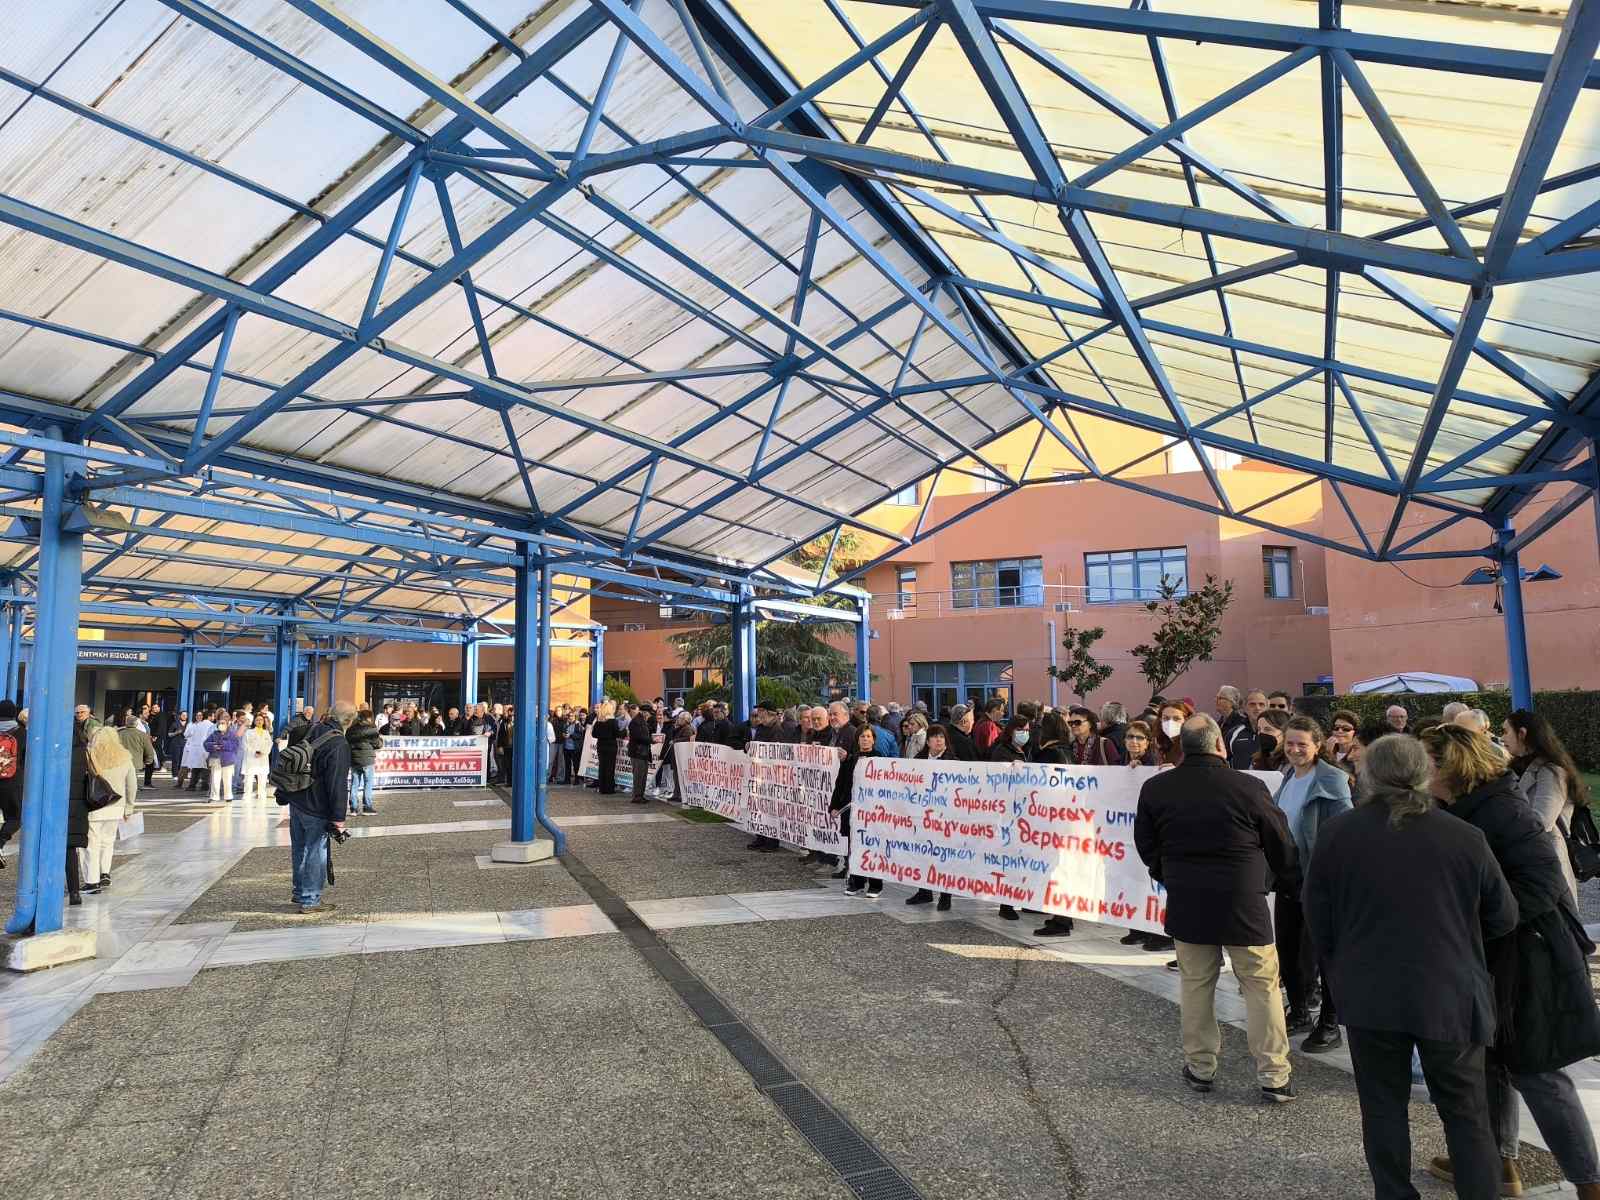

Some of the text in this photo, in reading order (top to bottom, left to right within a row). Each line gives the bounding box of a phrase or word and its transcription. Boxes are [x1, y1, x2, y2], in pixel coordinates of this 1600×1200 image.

[77, 650, 108, 658] ΕΝΤΡΙΚΗ
[384, 738, 476, 747] ΜΕ ΤΗ ΖΩΗ ΜΑΣ
[376, 750, 439, 760] ΟΥΝ ΤΩΡΑ
[407, 761, 431, 771] ΤΗΣ
[433, 761, 476, 771] ΥΓΕΙΑΣ
[1028, 790, 1096, 822] δωρεάν
[1017, 817, 1126, 861] θεραπείας
